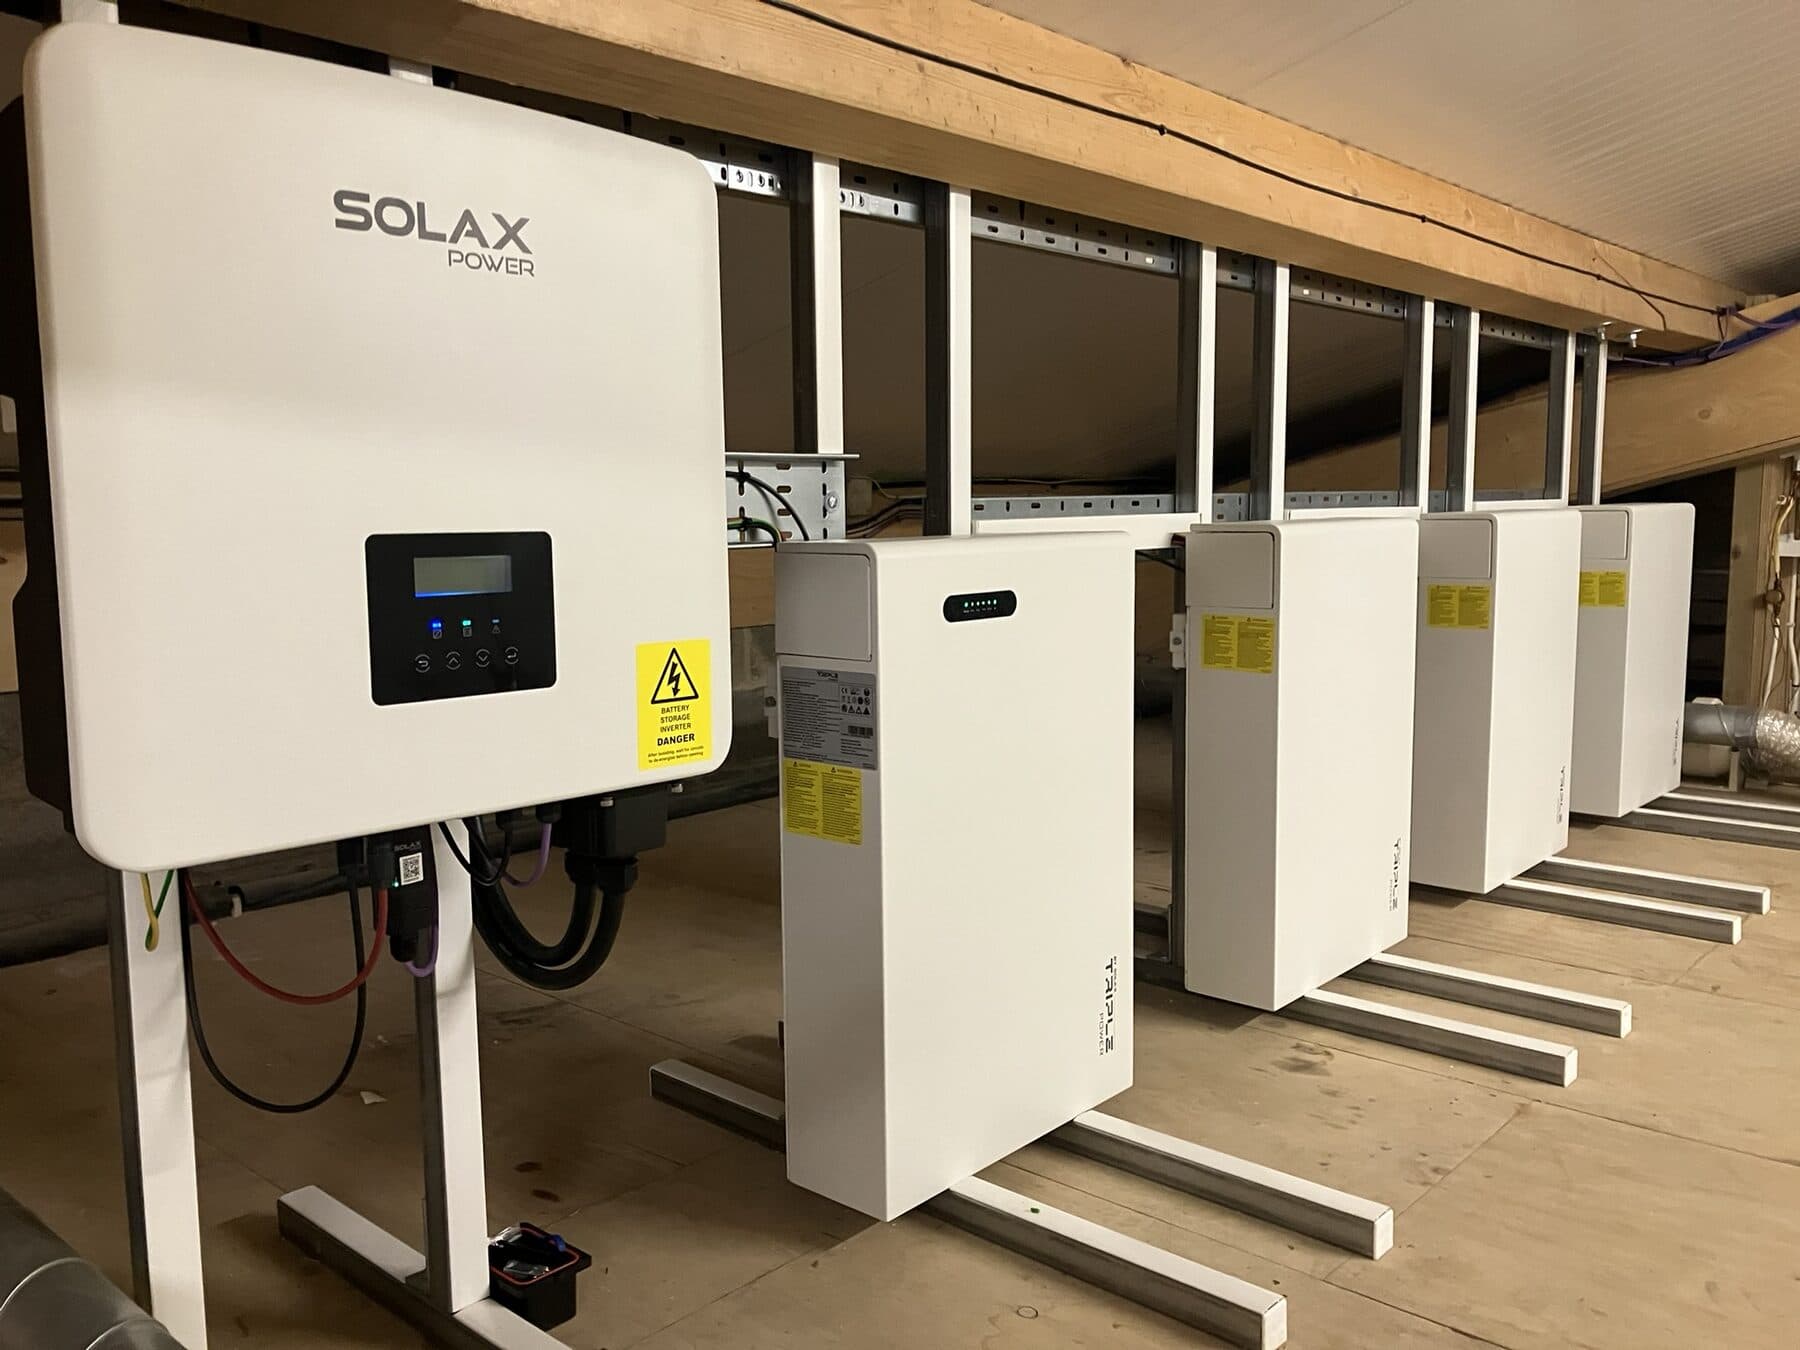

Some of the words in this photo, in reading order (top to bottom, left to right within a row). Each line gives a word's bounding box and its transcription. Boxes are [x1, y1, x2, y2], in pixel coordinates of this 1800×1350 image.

[333, 190, 533, 254] SOLAX
[447, 249, 535, 277] POWER
[661, 705, 690, 714] BATTERY
[660, 713, 691, 724] STORAGE
[660, 723, 691, 732] INVERTER
[657, 734, 695, 746] DANGER
[1105, 957, 1114, 1054] TRIPLE
